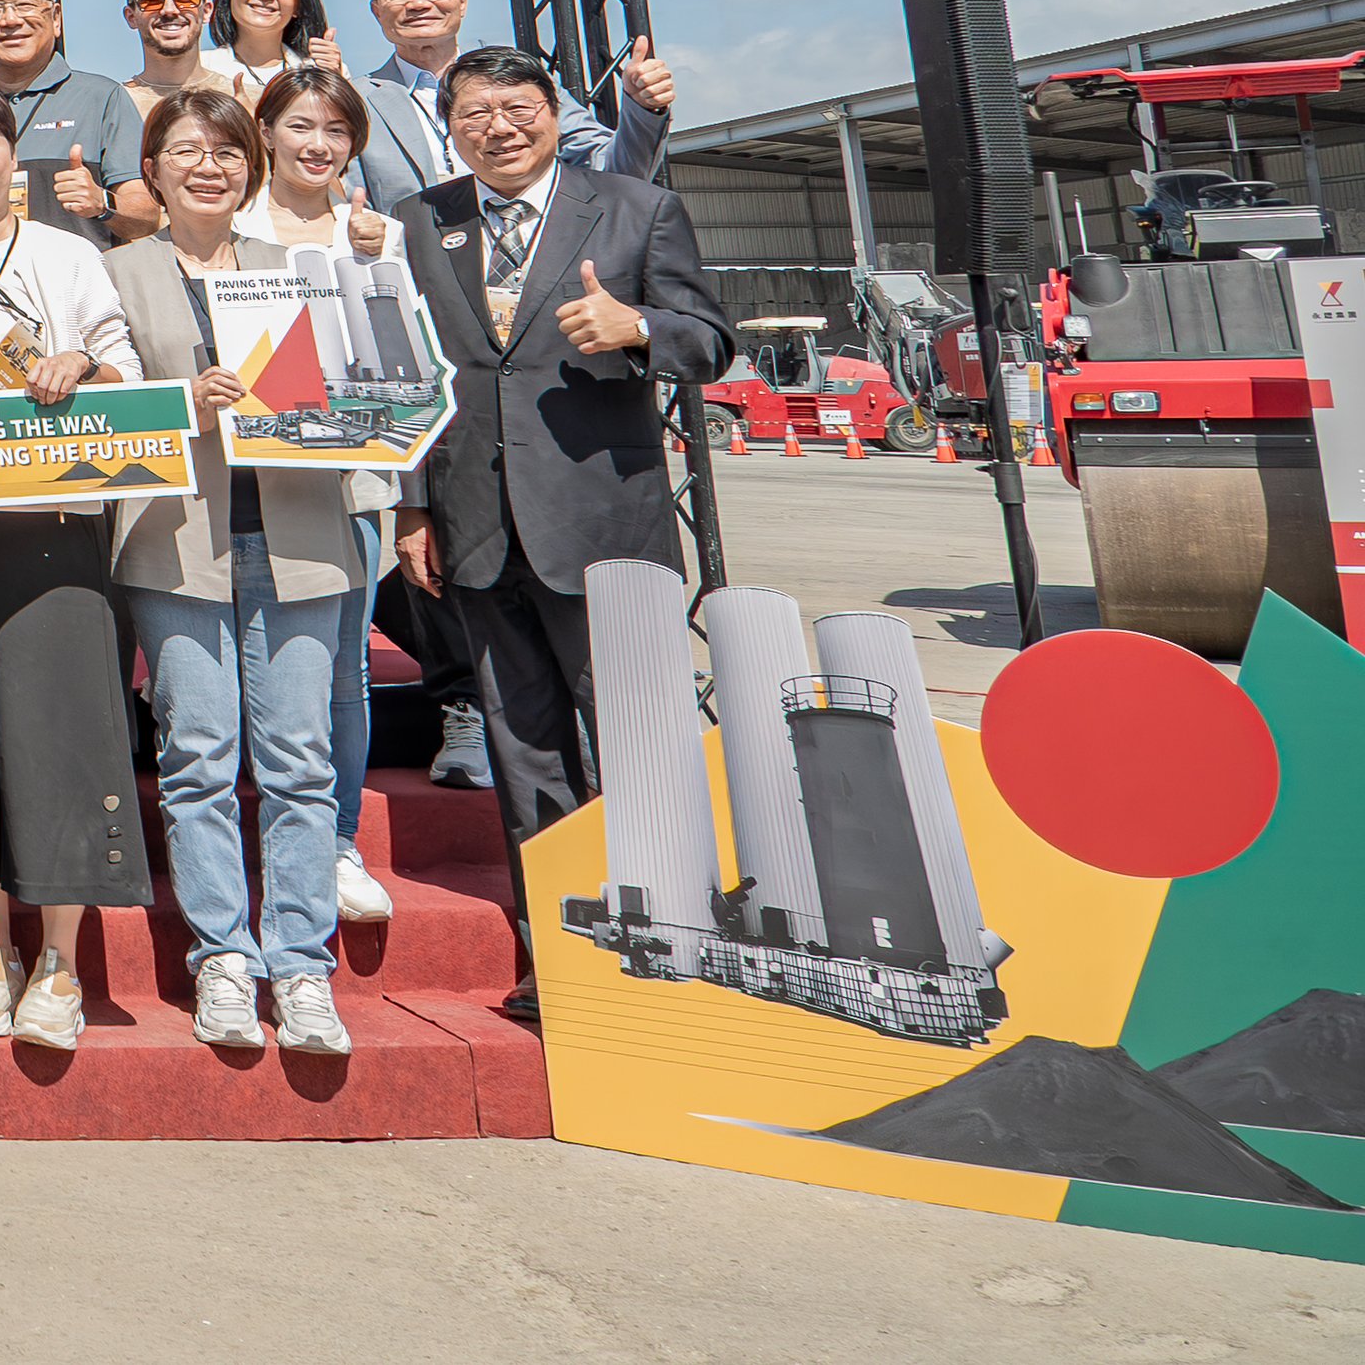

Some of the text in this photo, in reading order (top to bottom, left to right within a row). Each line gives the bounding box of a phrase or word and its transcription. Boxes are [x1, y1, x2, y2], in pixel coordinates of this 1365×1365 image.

[215, 277, 311, 290] PAVING THE WAY,
[217, 288, 347, 302] FORGING THE FUTURE.
[11, 418, 56, 438] THE
[60, 414, 114, 437] WAY,
[34, 443, 79, 465] THE
[84, 437, 182, 462] FUTURE.
